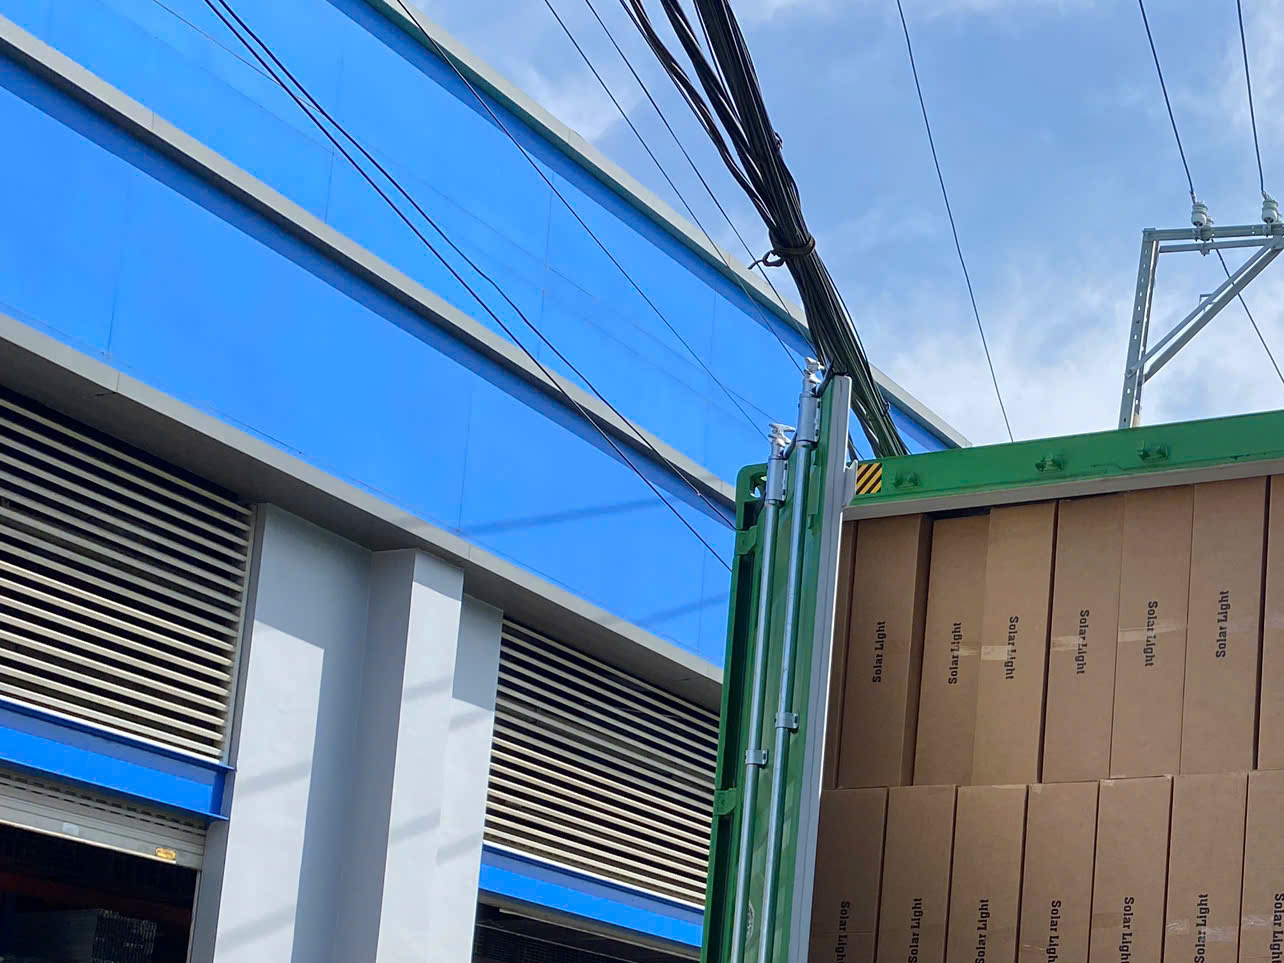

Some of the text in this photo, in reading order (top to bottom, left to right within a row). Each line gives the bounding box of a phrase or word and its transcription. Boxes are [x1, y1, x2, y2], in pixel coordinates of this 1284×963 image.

[871, 621, 887, 683] Solar Light
[947, 622, 963, 685] Solar Light
[1003, 615, 1019, 680] Solar Light
[1074, 609, 1090, 675] Solar Light
[1143, 600, 1159, 667] Solar Light
[1215, 590, 1231, 658] Solar Light
[839, 900, 851, 932] Solar
[907, 898, 924, 963] Solar Light
[976, 899, 991, 931] Light
[1049, 900, 1062, 933] Solar
[1122, 896, 1135, 930] Solar
[1193, 893, 1210, 963] Solar Light
